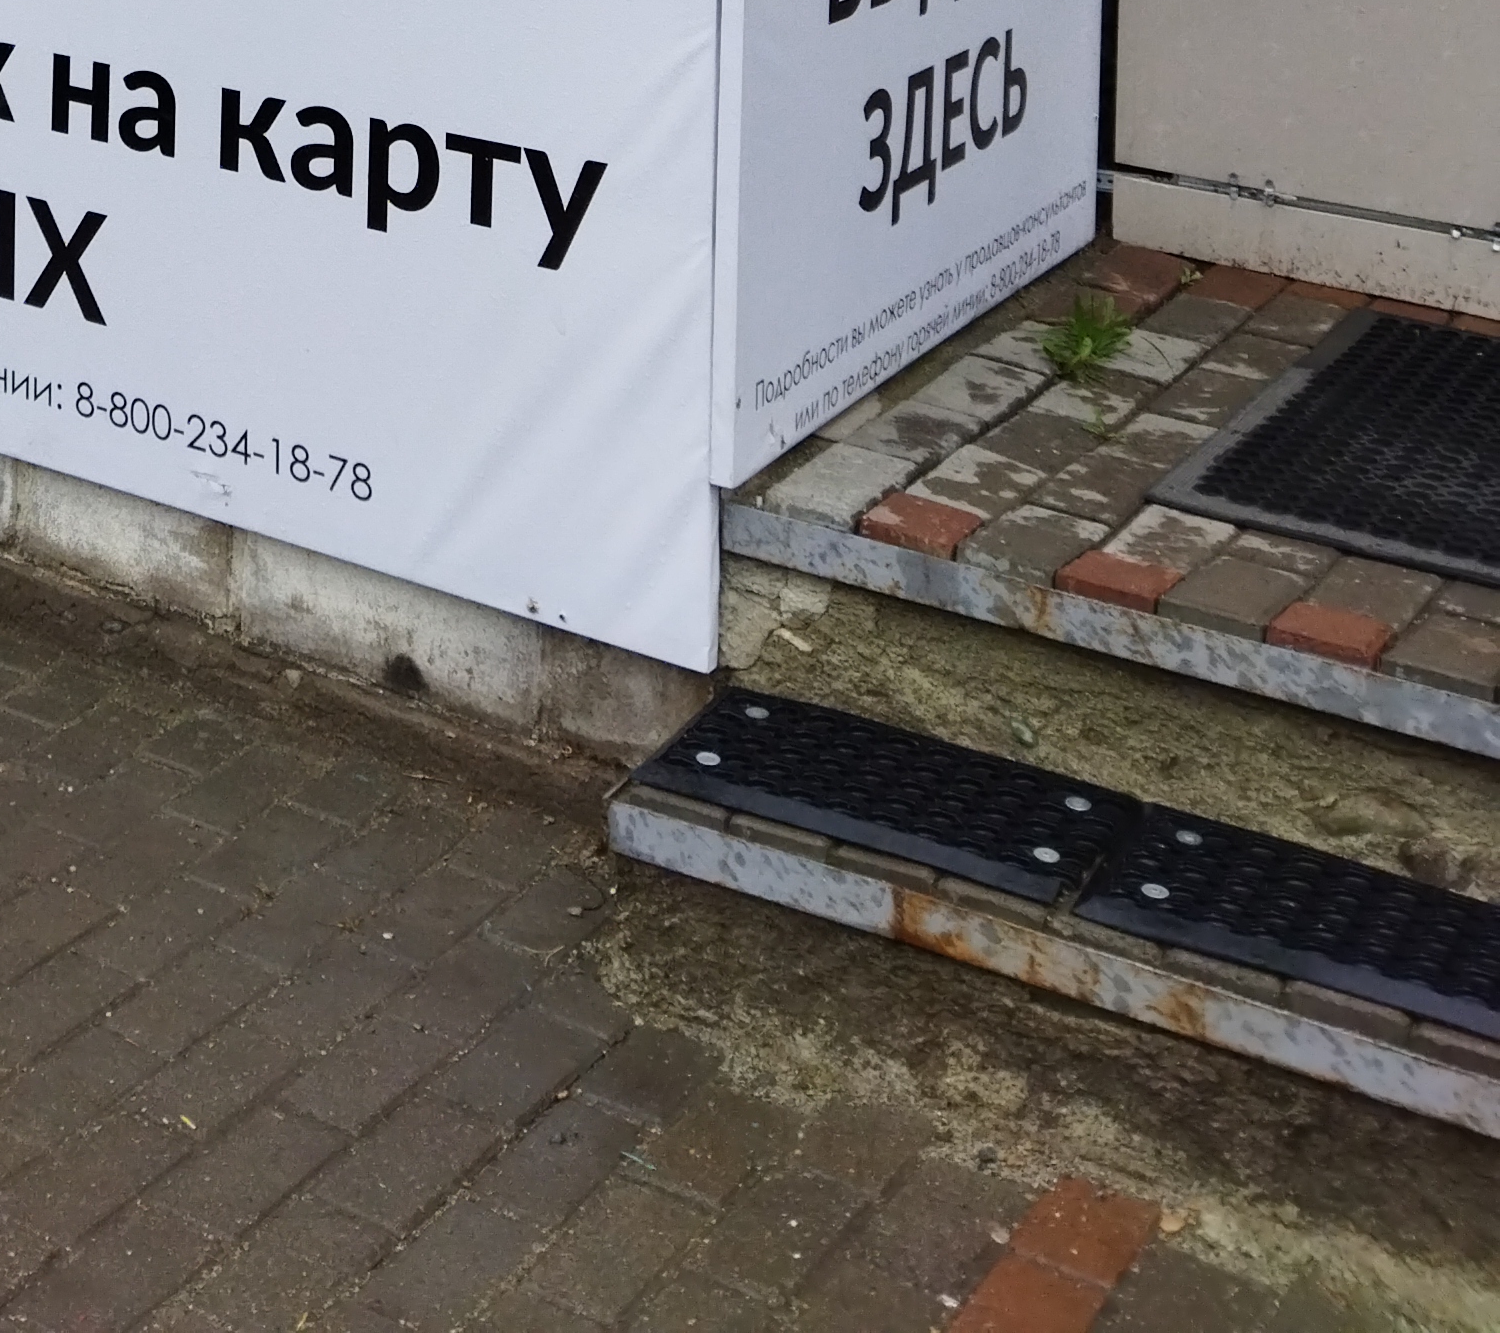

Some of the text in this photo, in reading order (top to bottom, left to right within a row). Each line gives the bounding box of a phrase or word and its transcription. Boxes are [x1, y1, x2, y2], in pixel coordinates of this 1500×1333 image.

[50, 51, 178, 159] на
[218, 85, 609, 273] карту
[857, 27, 1030, 227] ЗДЕСЬ
[753, 180, 1087, 412] Подробности вы можете узнать у продавцов-консультантов
[794, 229, 1061, 432] или по телефону горячей линии: 8-800-234-18-78
[74, 380, 375, 503] 8-800-234-18-78
